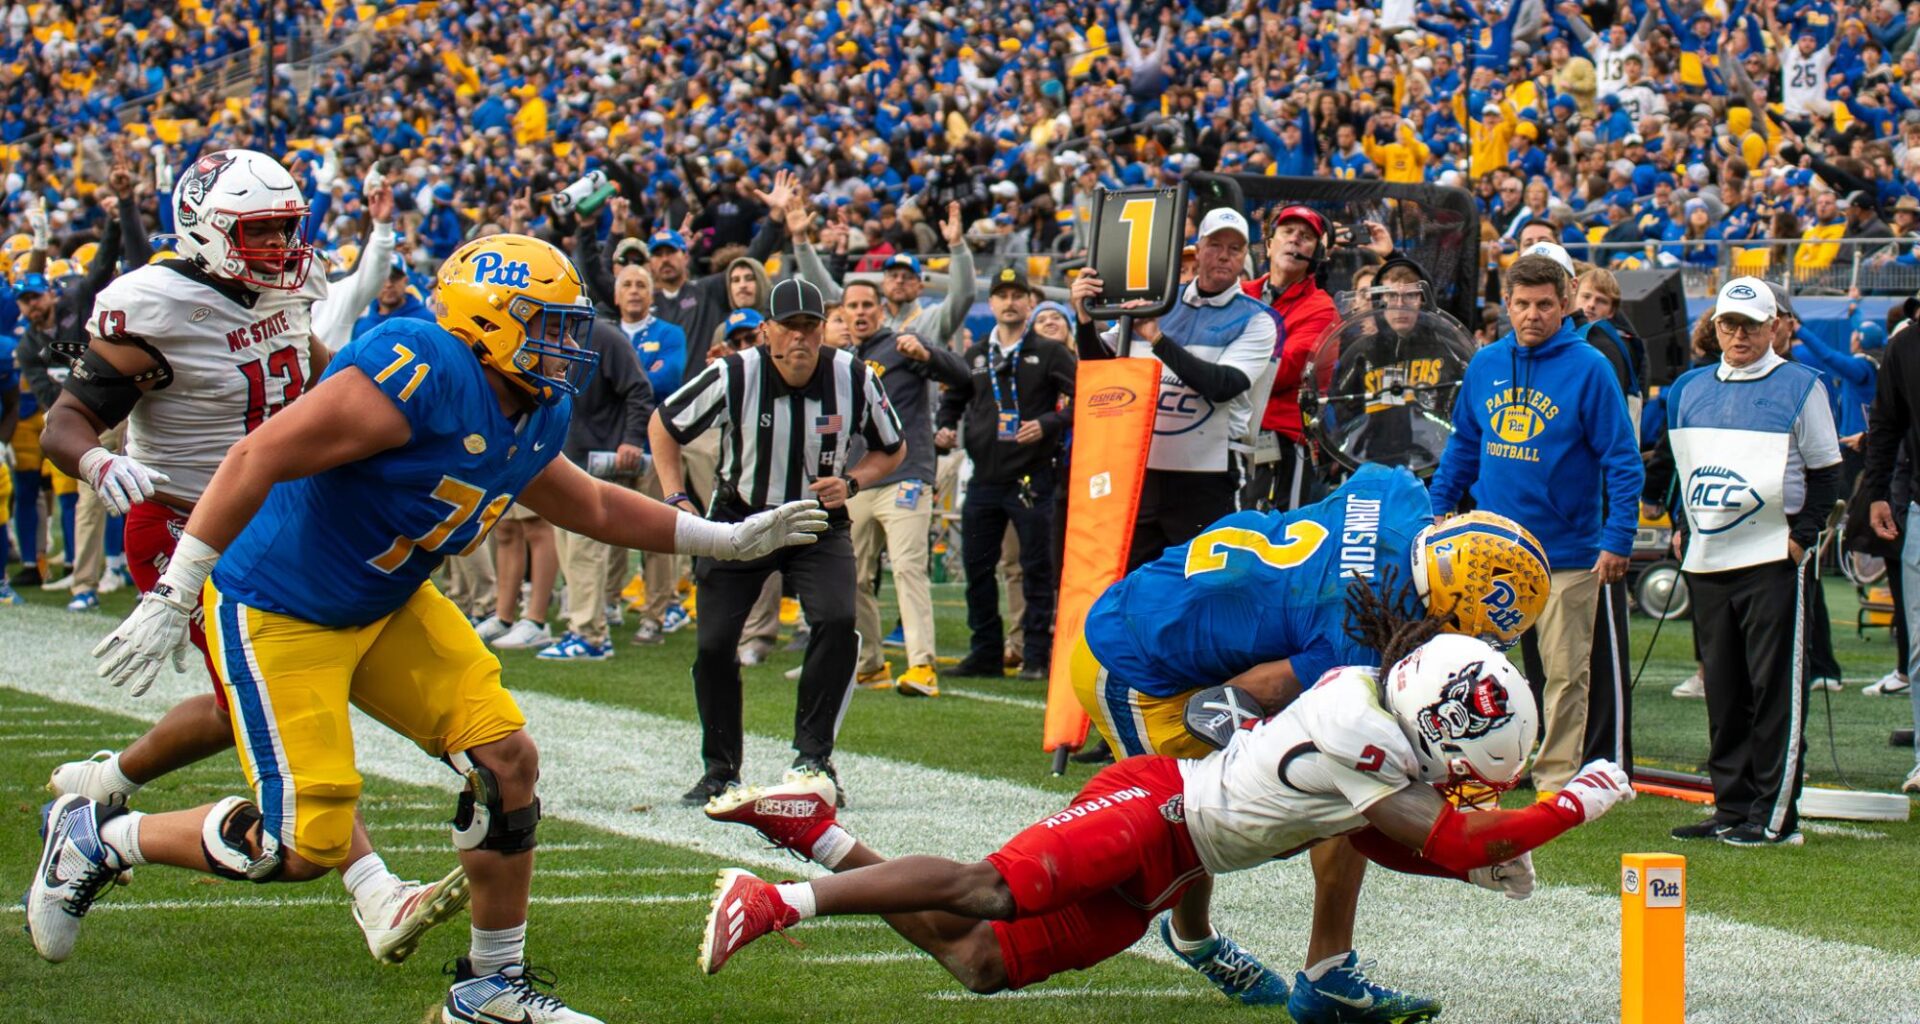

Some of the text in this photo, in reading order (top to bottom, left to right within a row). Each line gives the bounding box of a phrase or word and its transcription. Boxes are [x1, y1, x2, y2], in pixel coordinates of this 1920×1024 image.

[1603, 58, 1624, 81] 13
[1790, 62, 1818, 87] 25
[1118, 198, 1157, 291] 1
[471, 252, 531, 289] Pitt
[99, 310, 127, 338] 13
[226, 310, 290, 352] NC STATE
[374, 343, 431, 402] 71
[1157, 391, 1201, 414] CC
[760, 413, 771, 427] S
[1487, 441, 1540, 462] FOOTBALL
[1691, 483, 1748, 507] ACC
[366, 475, 514, 574] 71
[1340, 494, 1381, 578] JOHNSON
[1185, 520, 1329, 579] 2
[1480, 579, 1524, 633] Pitt
[1480, 695, 1495, 714] STATE
[1355, 744, 1386, 772] 2
[1040, 786, 1151, 828] WOLFPACK
[1649, 878, 1679, 897] Pitt
